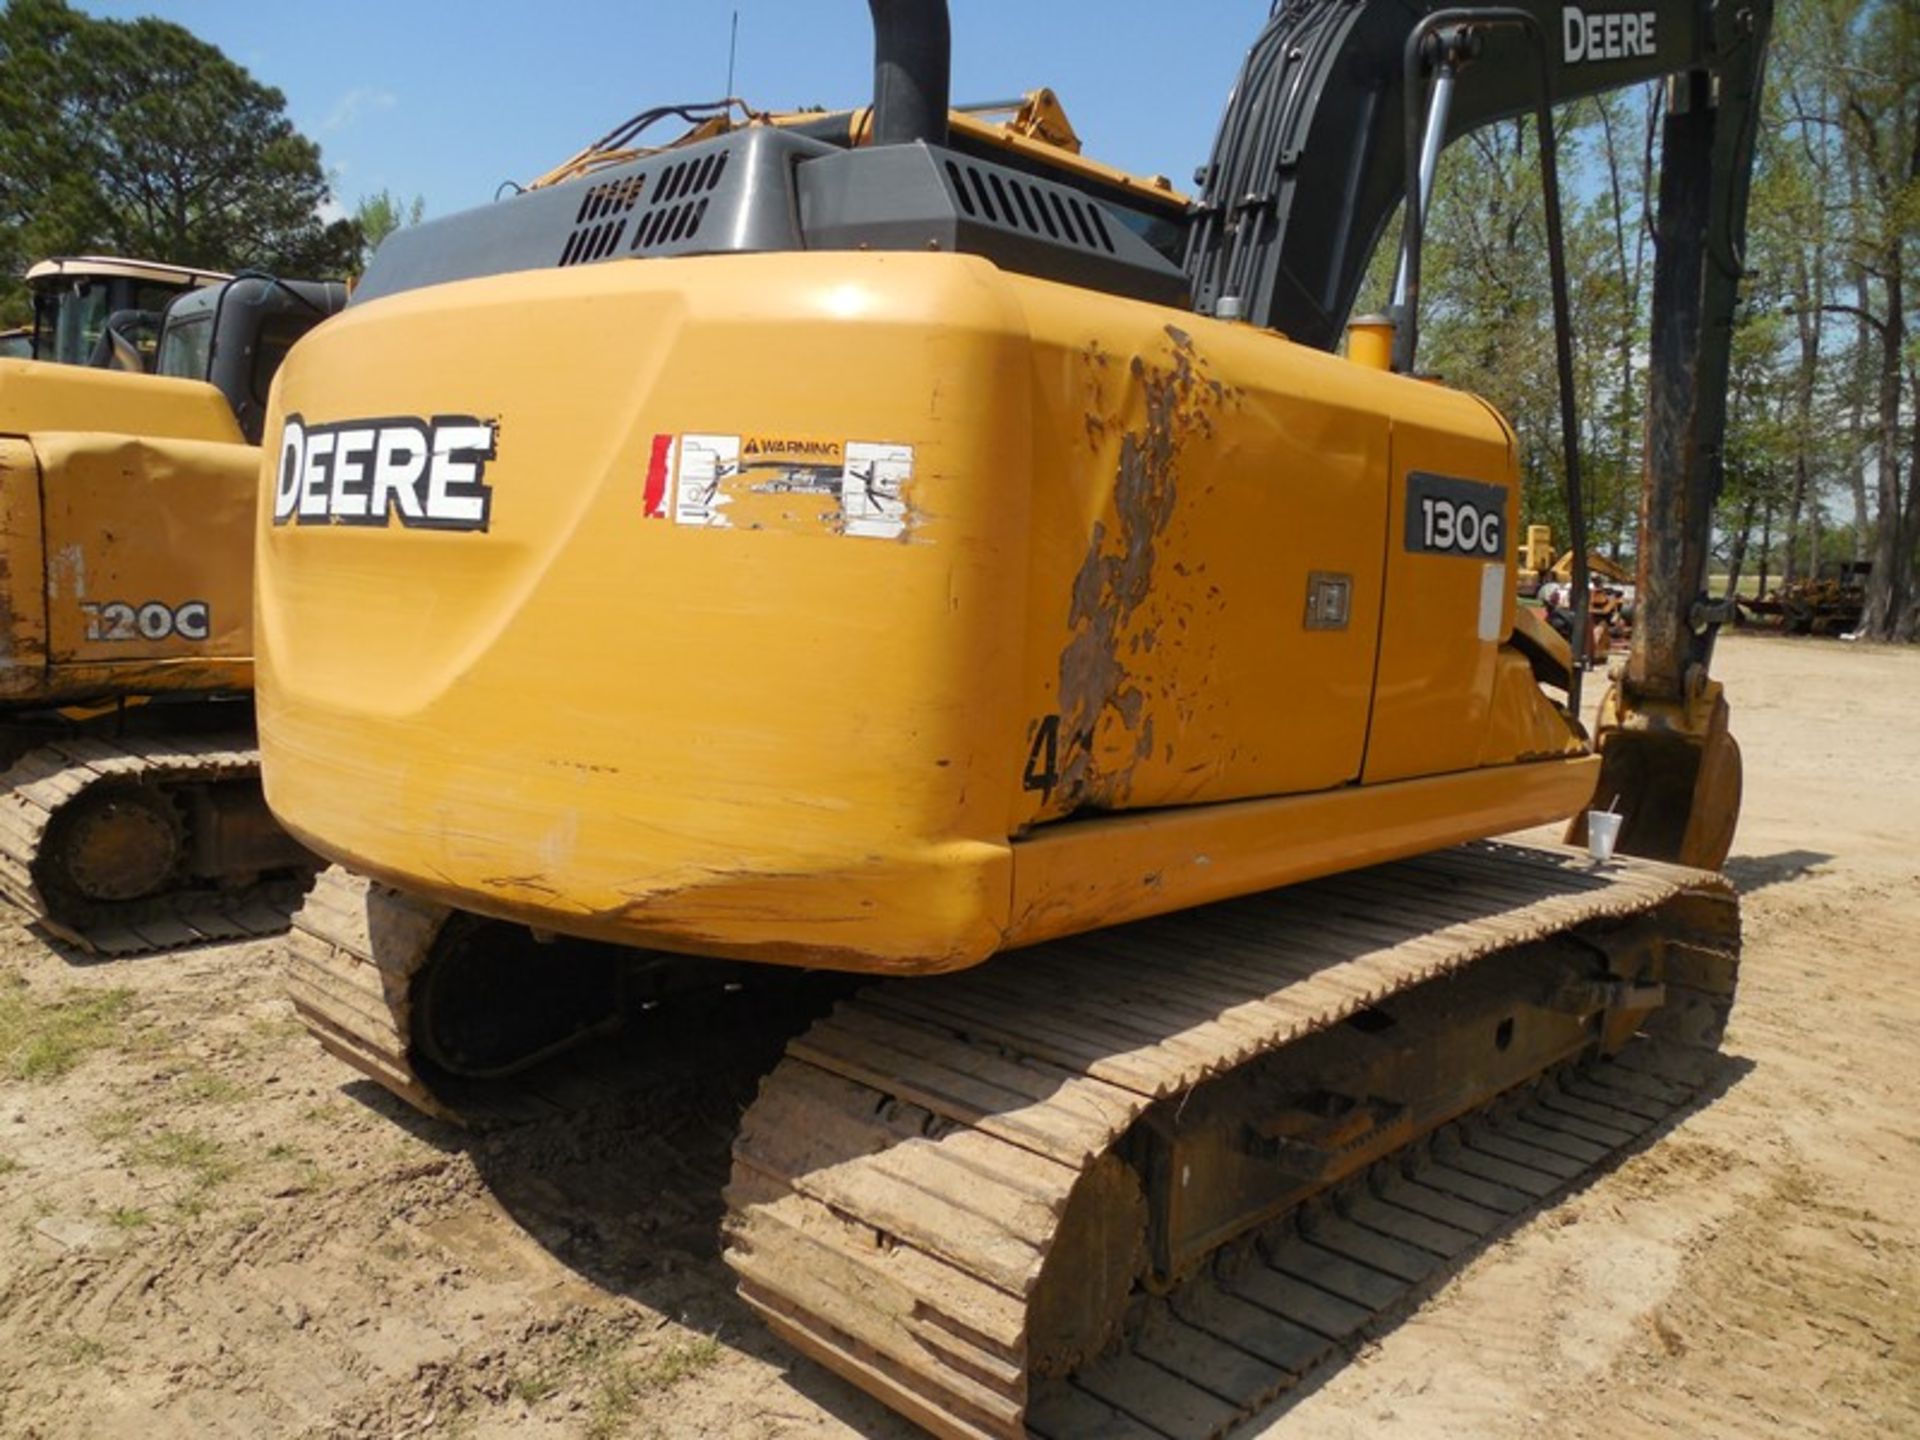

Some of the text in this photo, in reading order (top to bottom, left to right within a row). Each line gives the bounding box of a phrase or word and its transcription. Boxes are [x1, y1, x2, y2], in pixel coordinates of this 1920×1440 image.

[1562, 6, 1657, 63] DEERE
[274, 420, 493, 522] DEERE
[760, 440, 839, 455] WARNING
[1422, 498, 1499, 553] 130G
[82, 602, 207, 639] 120C
